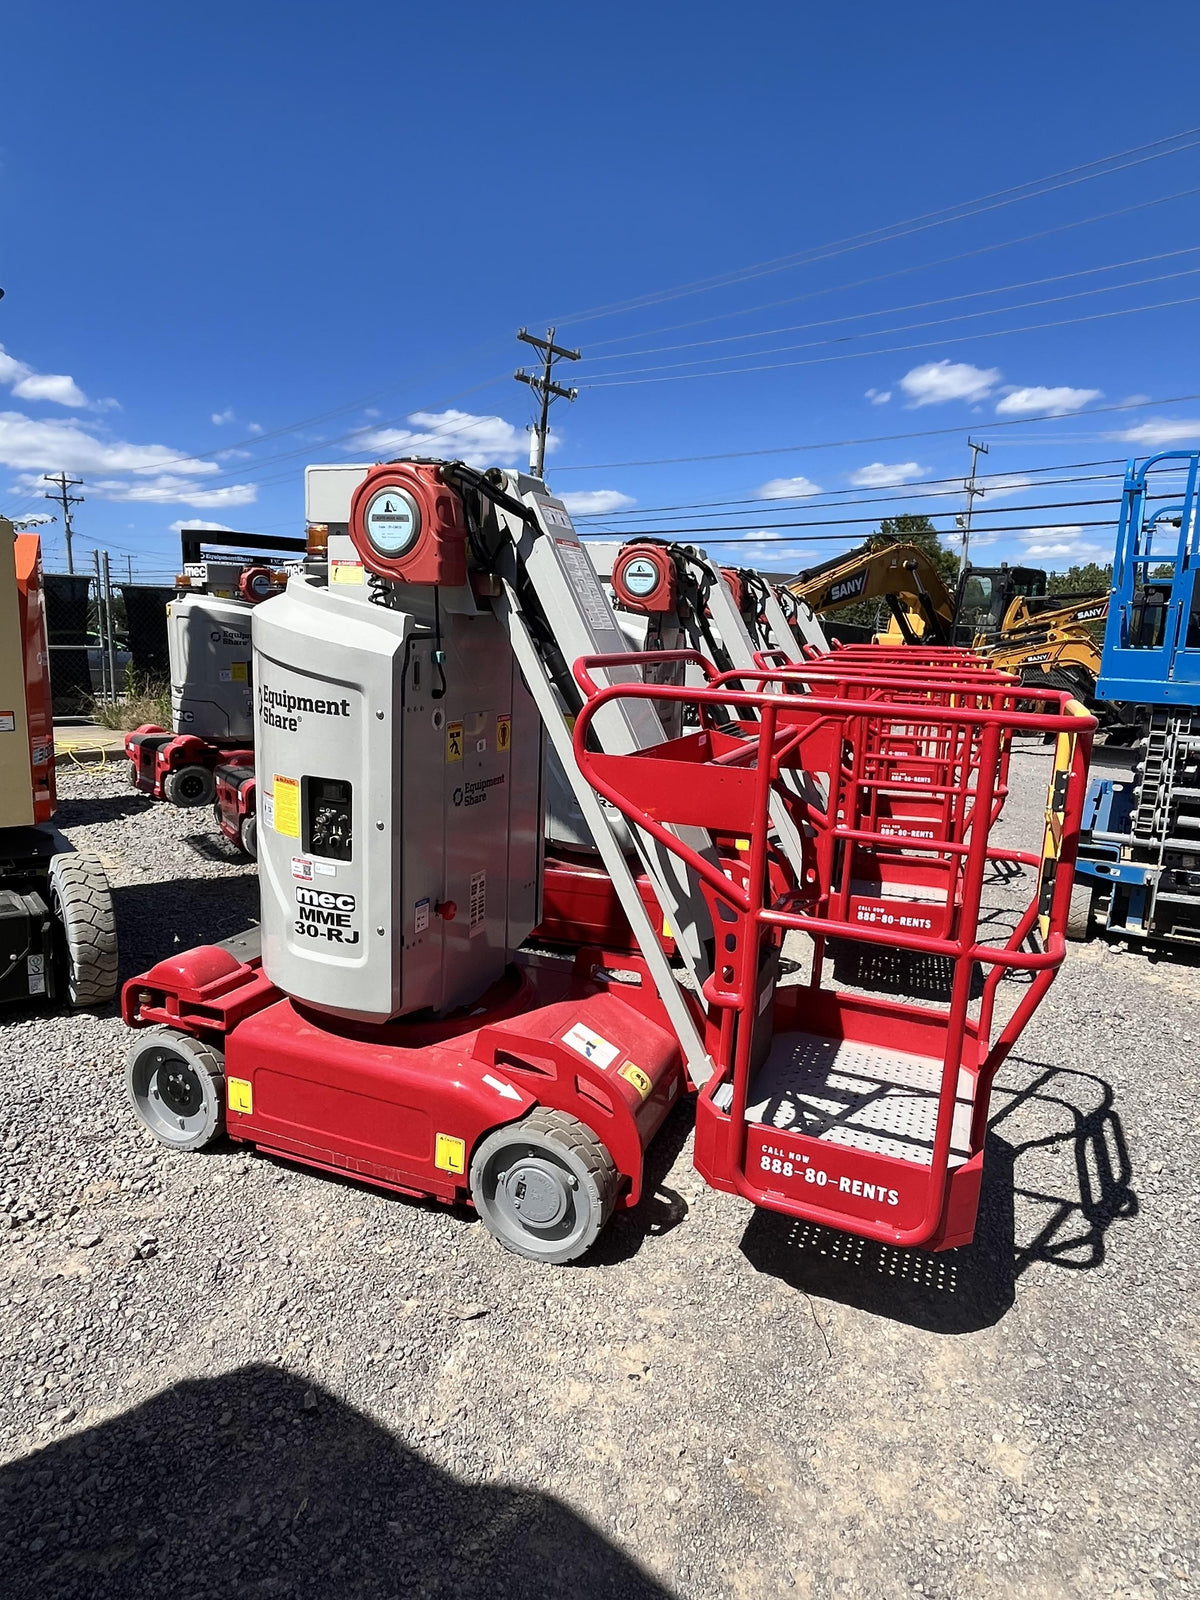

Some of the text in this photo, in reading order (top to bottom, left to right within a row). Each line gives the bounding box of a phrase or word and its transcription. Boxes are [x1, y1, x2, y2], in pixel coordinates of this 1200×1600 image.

[184, 564, 206, 577] mec
[831, 576, 862, 600] SANY
[1077, 607, 1102, 619] SANY
[1027, 654, 1047, 662] SANY
[263, 684, 350, 717] Equipment
[464, 774, 505, 795] Equipment
[464, 792, 487, 807] Share
[880, 828, 934, 839] 888-80-RENTS
[296, 887, 355, 911] mec
[300, 906, 352, 929] MME
[857, 911, 932, 929] 888-80-RENTS
[295, 920, 360, 945] 30-RJ
[761, 1144, 810, 1164] CALL NOW
[760, 1155, 899, 1206] 888-80-RENTS
